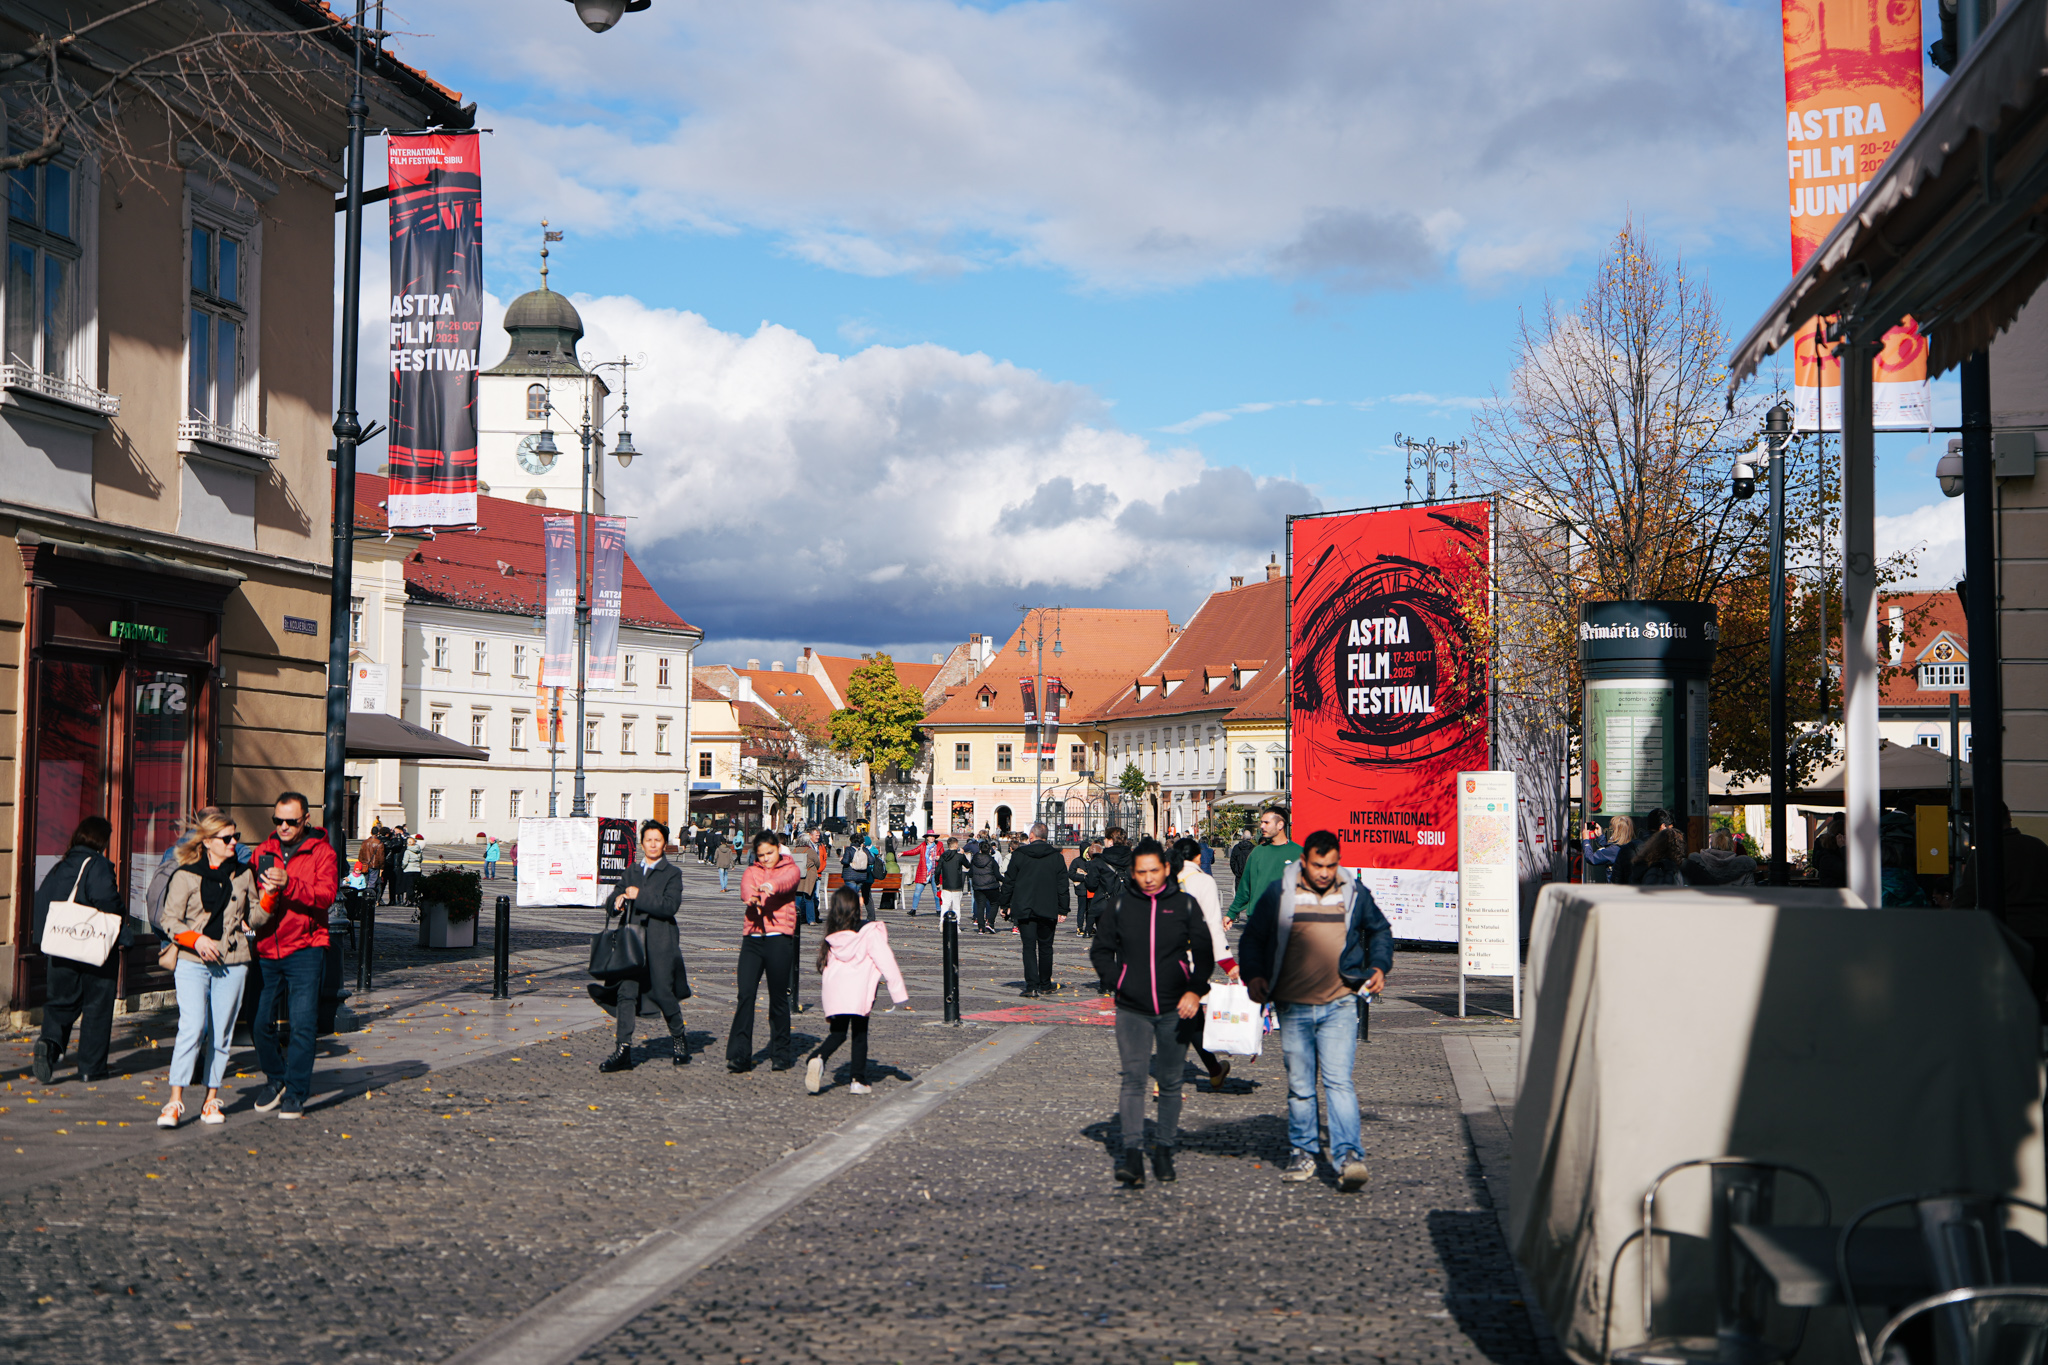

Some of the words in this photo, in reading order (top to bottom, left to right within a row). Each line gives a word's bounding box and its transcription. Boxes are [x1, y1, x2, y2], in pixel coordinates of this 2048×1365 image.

[1787, 102, 1887, 142] ASTRA
[389, 148, 446, 157] INTERNATIONAL
[389, 157, 408, 165] FILM
[408, 156, 443, 165] FESTIVAL,
[443, 156, 463, 164] SIBIU
[1788, 144, 1855, 179] FILM
[1861, 158, 1889, 173] 202
[390, 293, 455, 318] ASTRA
[390, 321, 434, 345] FILM
[435, 321, 460, 331] 17-26
[462, 321, 481, 331] OCT
[435, 333, 459, 343] 2025
[390, 348, 479, 373] FESTIVAL
[110, 620, 169, 643] FARMACIE
[1347, 616, 1411, 647] ASTRA
[1642, 621, 1688, 640] Sibiu
[1347, 651, 1390, 681] FILM
[1393, 651, 1415, 663] 17-26
[1416, 650, 1433, 662] OCT
[1393, 667, 1414, 679] 2025
[1347, 685, 1436, 715] FESTIVAL
[1349, 811, 1433, 826] INTERNATIONAL
[603, 828, 622, 842] ASTRA
[1338, 828, 1361, 843] FILM
[1363, 829, 1415, 847] FESTIVAL,
[1417, 830, 1446, 846] SIBIU
[601, 843, 616, 855] FILM
[600, 857, 626, 870] FESTIVAL
[50, 925, 77, 937] ASTRA
